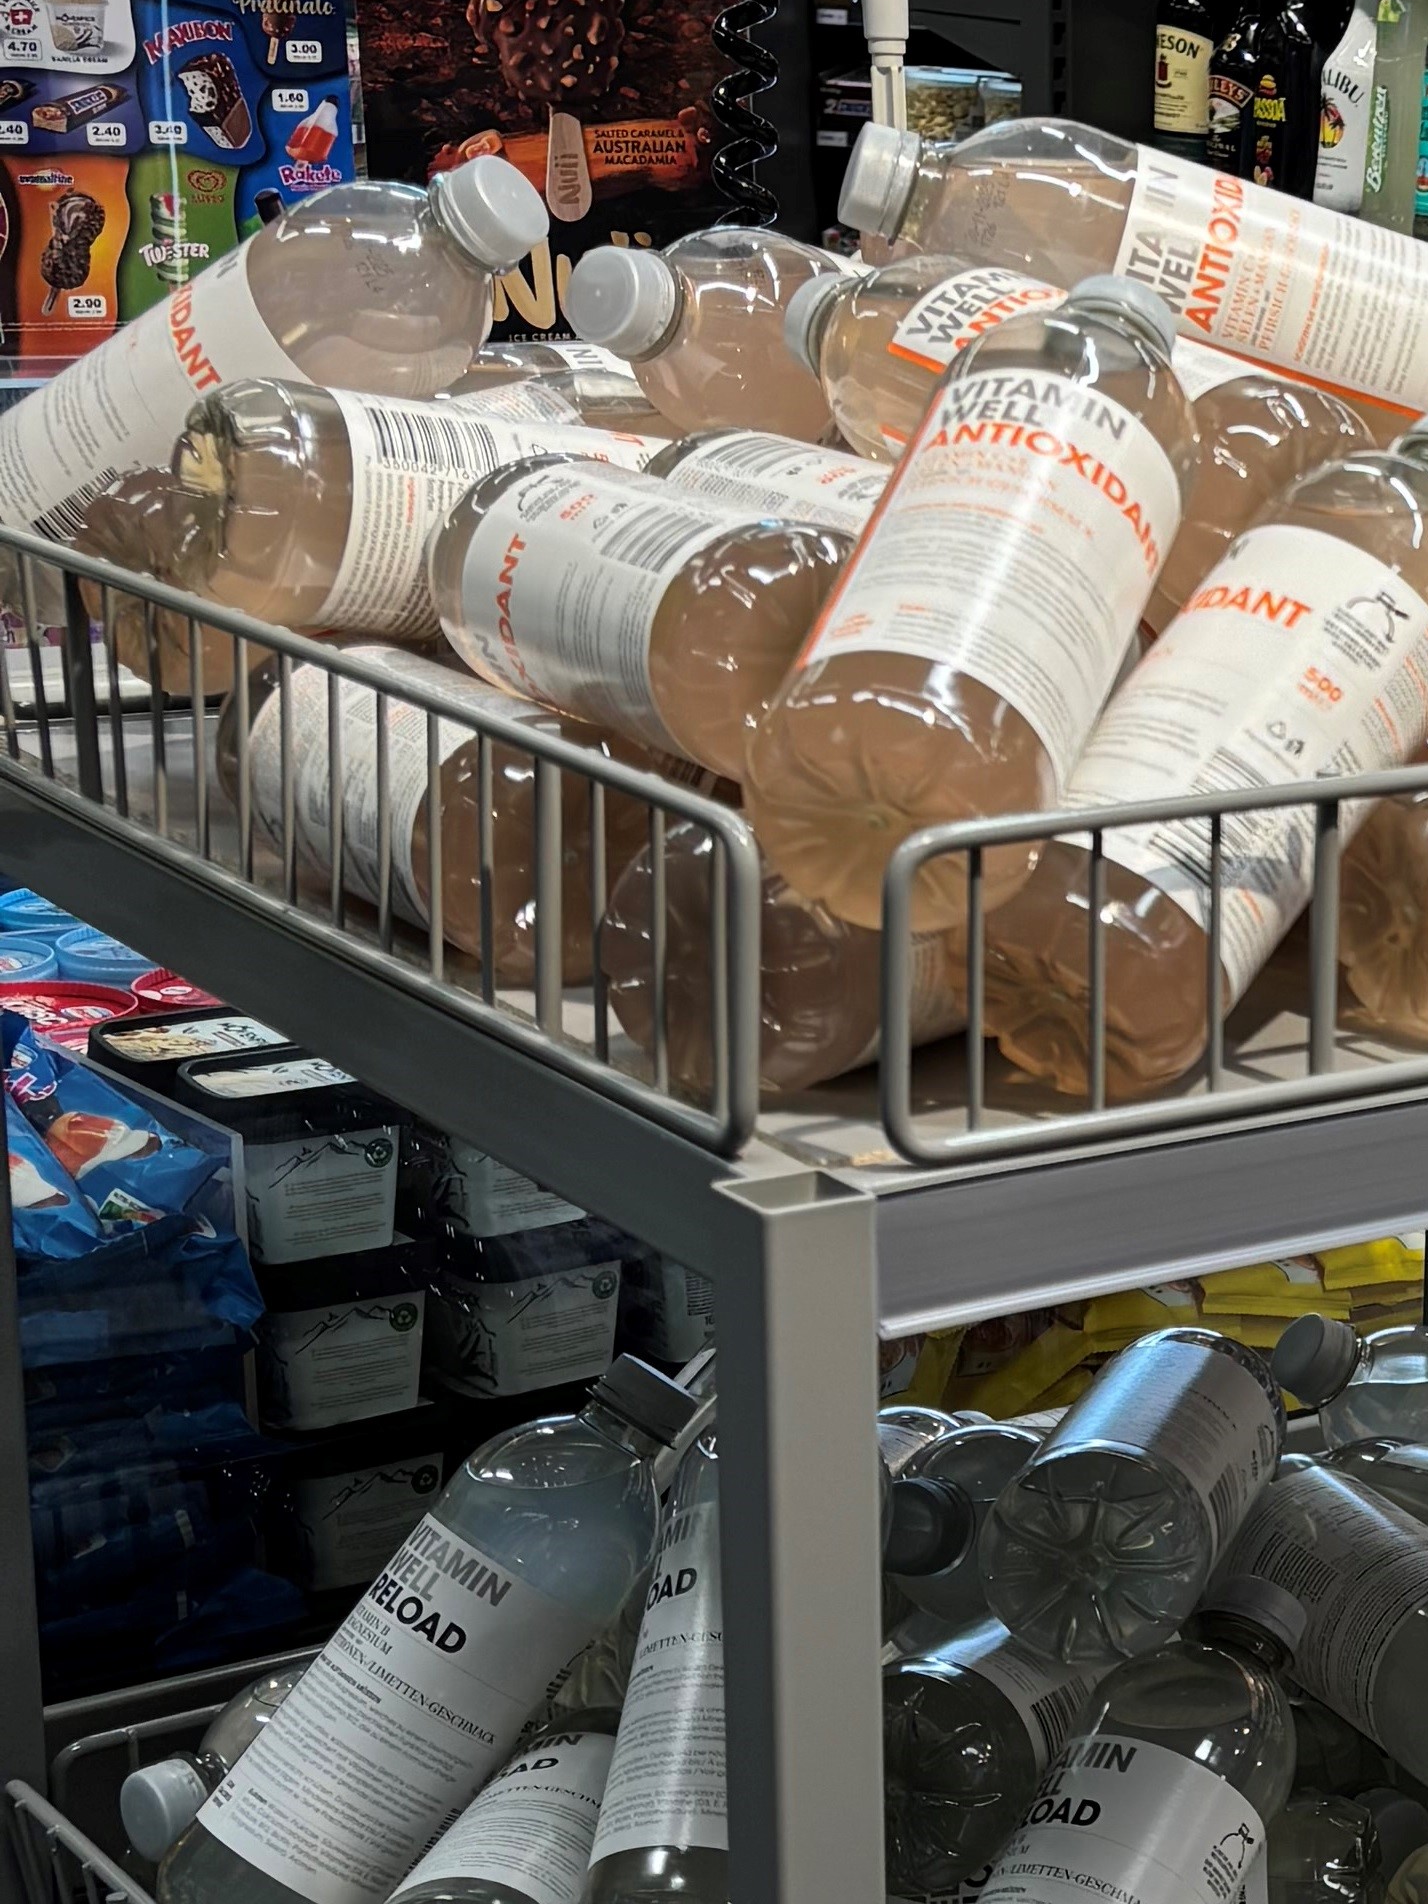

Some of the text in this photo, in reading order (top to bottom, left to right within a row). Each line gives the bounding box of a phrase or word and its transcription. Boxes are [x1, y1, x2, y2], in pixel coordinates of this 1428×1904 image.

[941, 399, 1043, 427] WELL
[395, 1548, 440, 1603] WELL
[409, 1521, 512, 1608] VITAMIN
[367, 1572, 467, 1655] RELOAD
